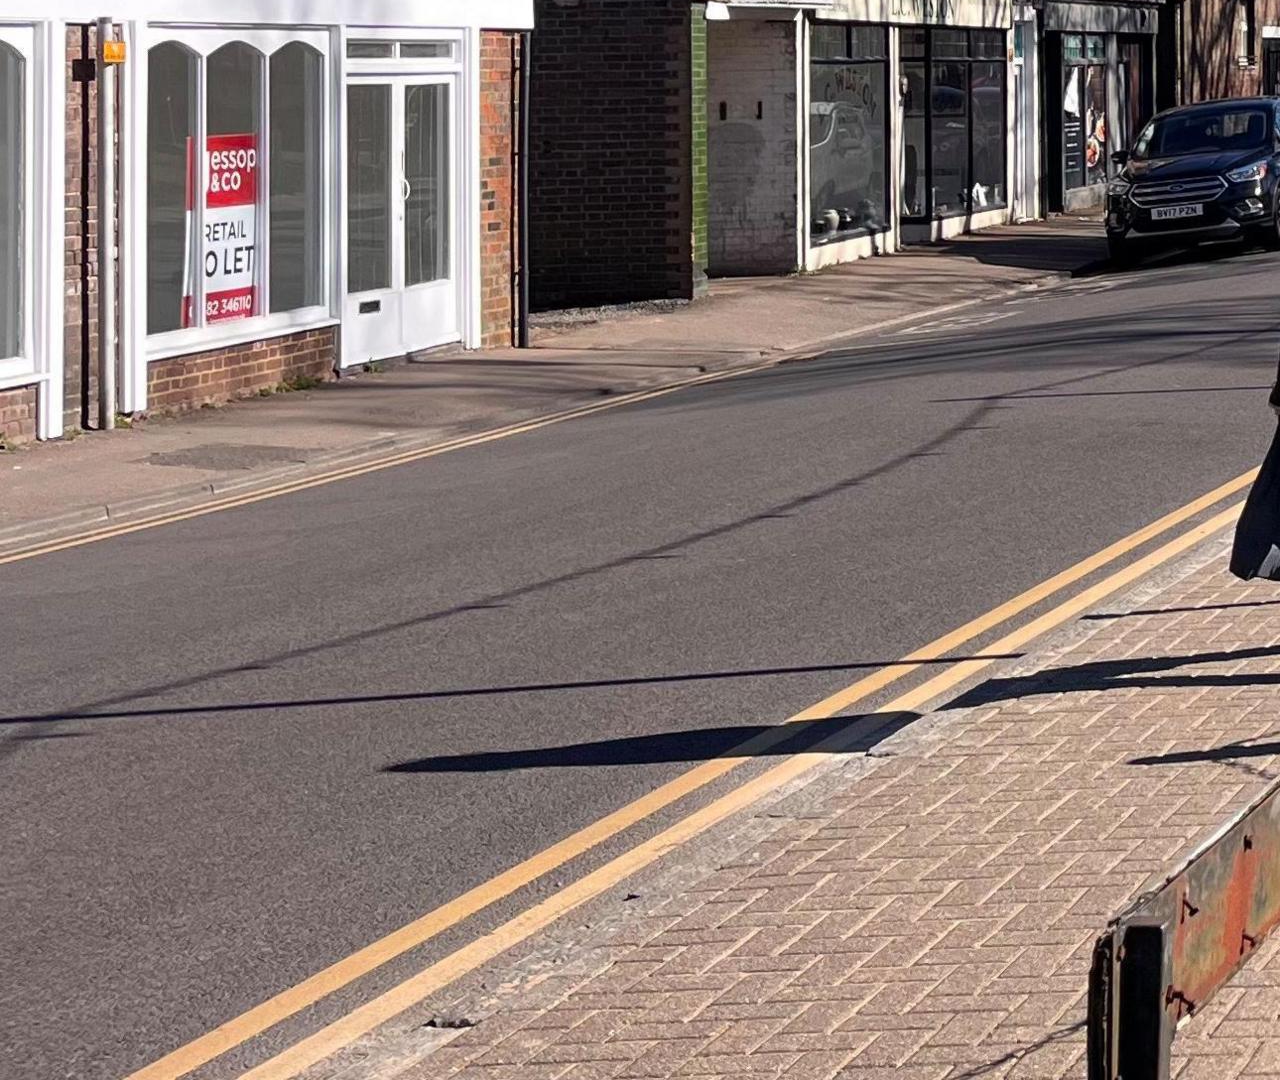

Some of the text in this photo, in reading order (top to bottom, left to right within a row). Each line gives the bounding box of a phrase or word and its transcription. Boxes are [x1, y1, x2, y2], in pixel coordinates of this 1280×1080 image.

[211, 171, 241, 192] &CO
[205, 220, 247, 242] RETAIL
[205, 245, 255, 278] O LET
[220, 294, 252, 314] 346110
